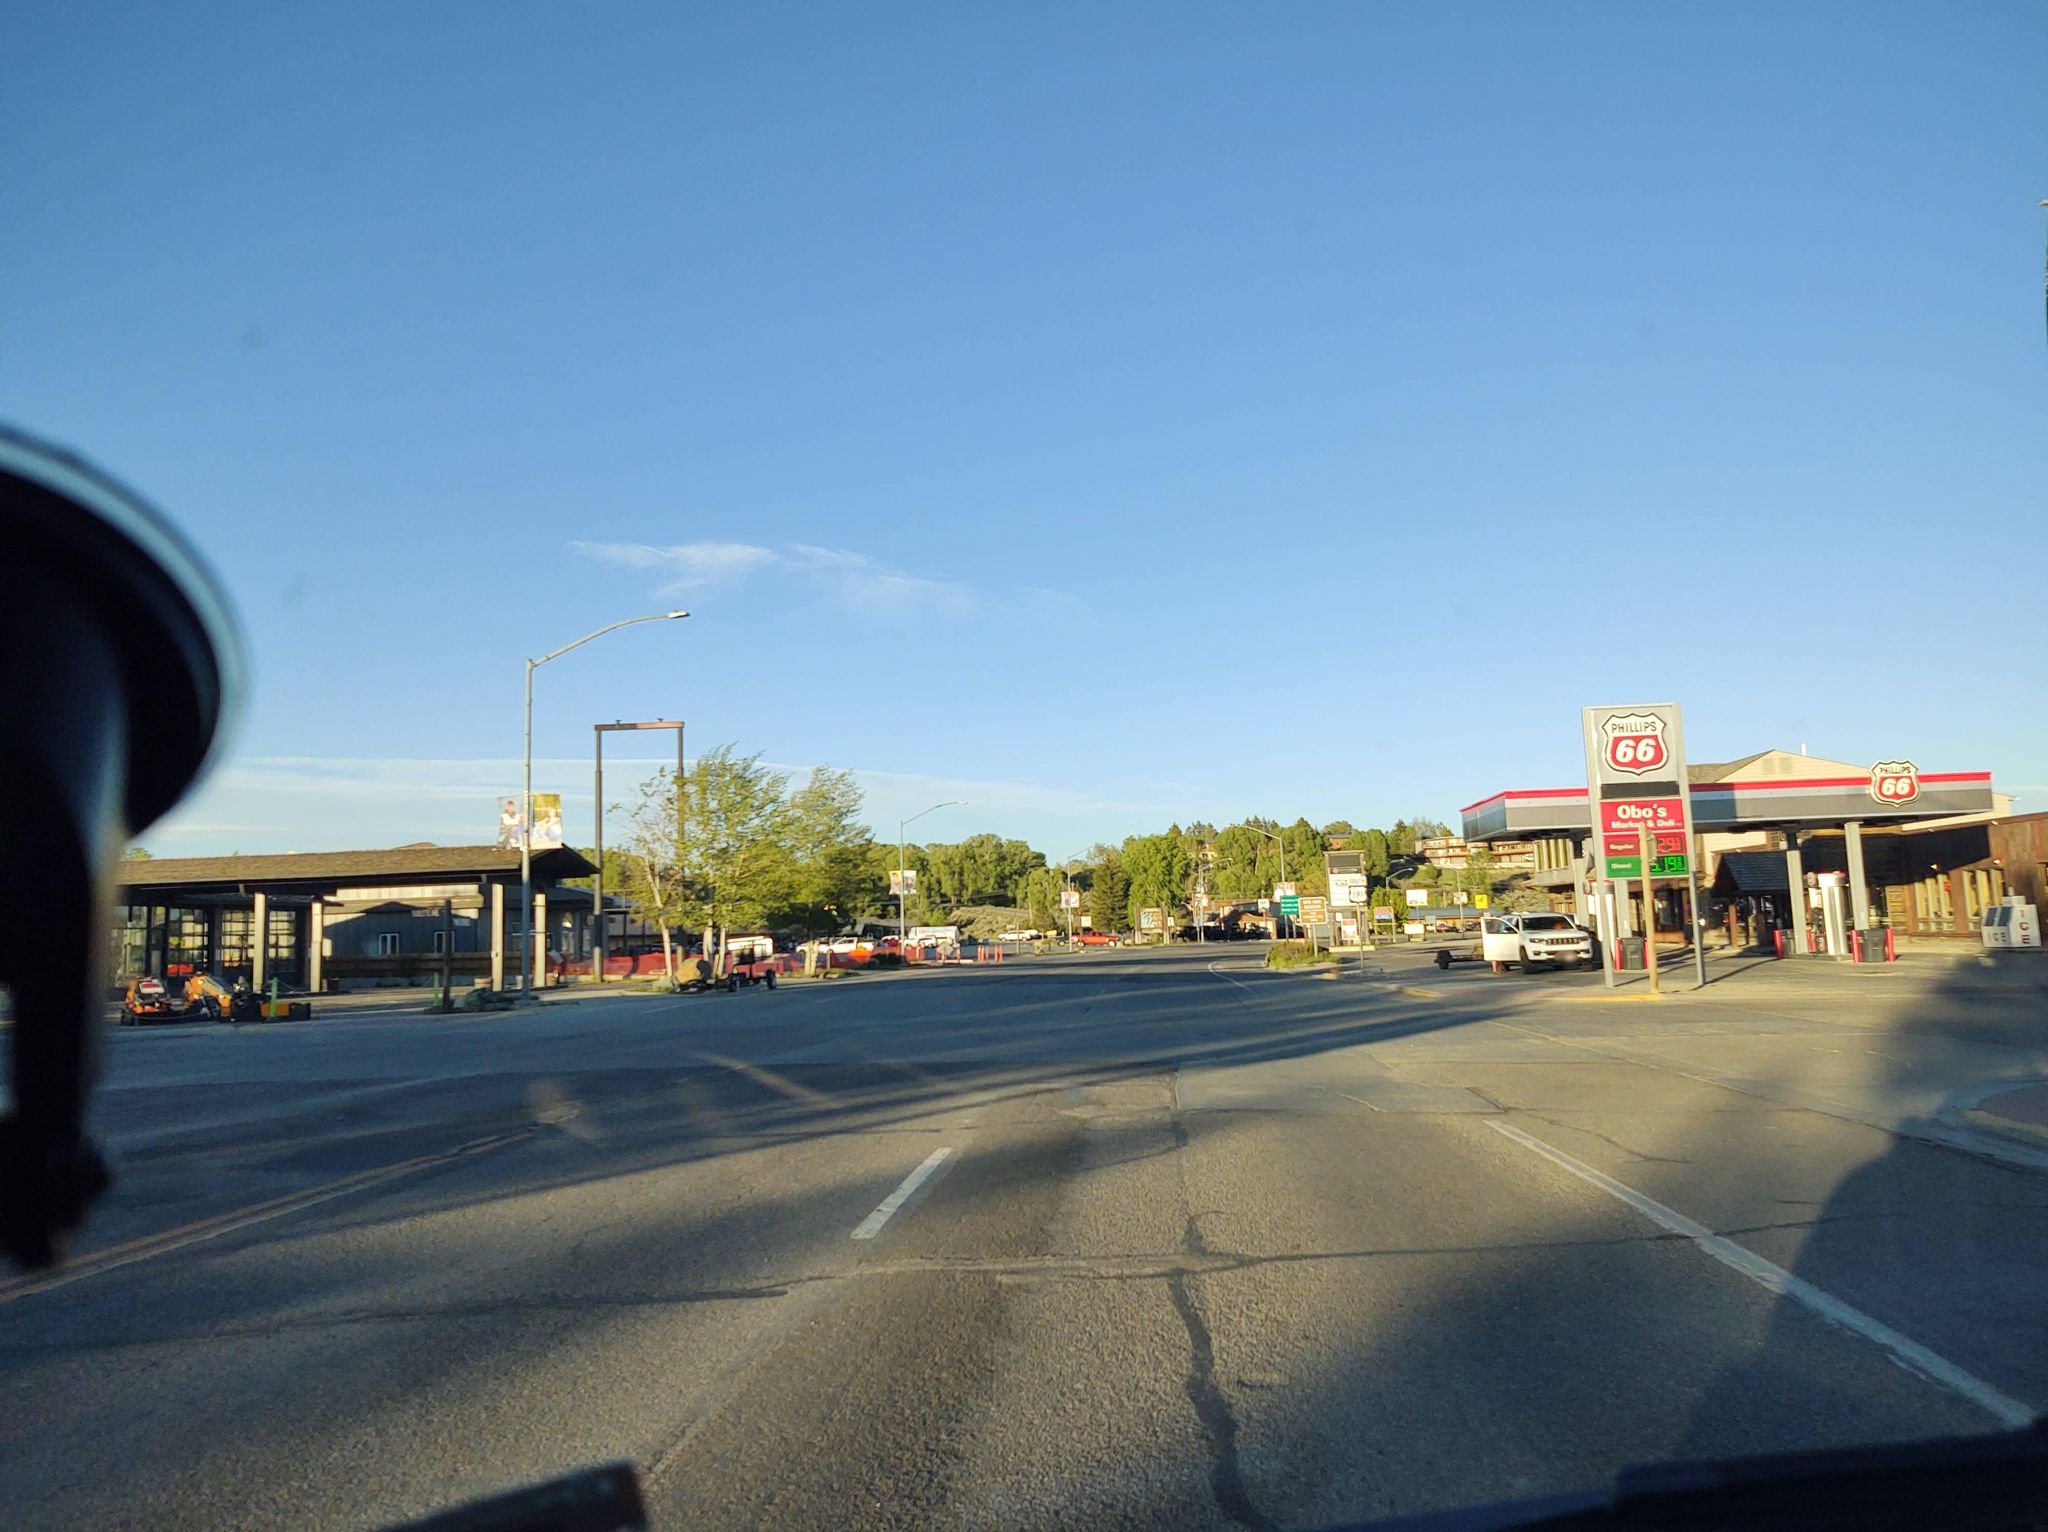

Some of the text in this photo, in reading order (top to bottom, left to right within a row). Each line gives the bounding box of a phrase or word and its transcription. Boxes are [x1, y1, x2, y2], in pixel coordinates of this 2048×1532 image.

[1611, 721, 1657, 733] PHILLIPS
[1615, 738, 1656, 762] 66
[1879, 766, 1911, 774] PHILLIPS
[1881, 777, 1911, 795] 66
[1616, 803, 1667, 818] Obo's
[1646, 820, 1654, 828] &
[2018, 909, 2030, 944] ICE
